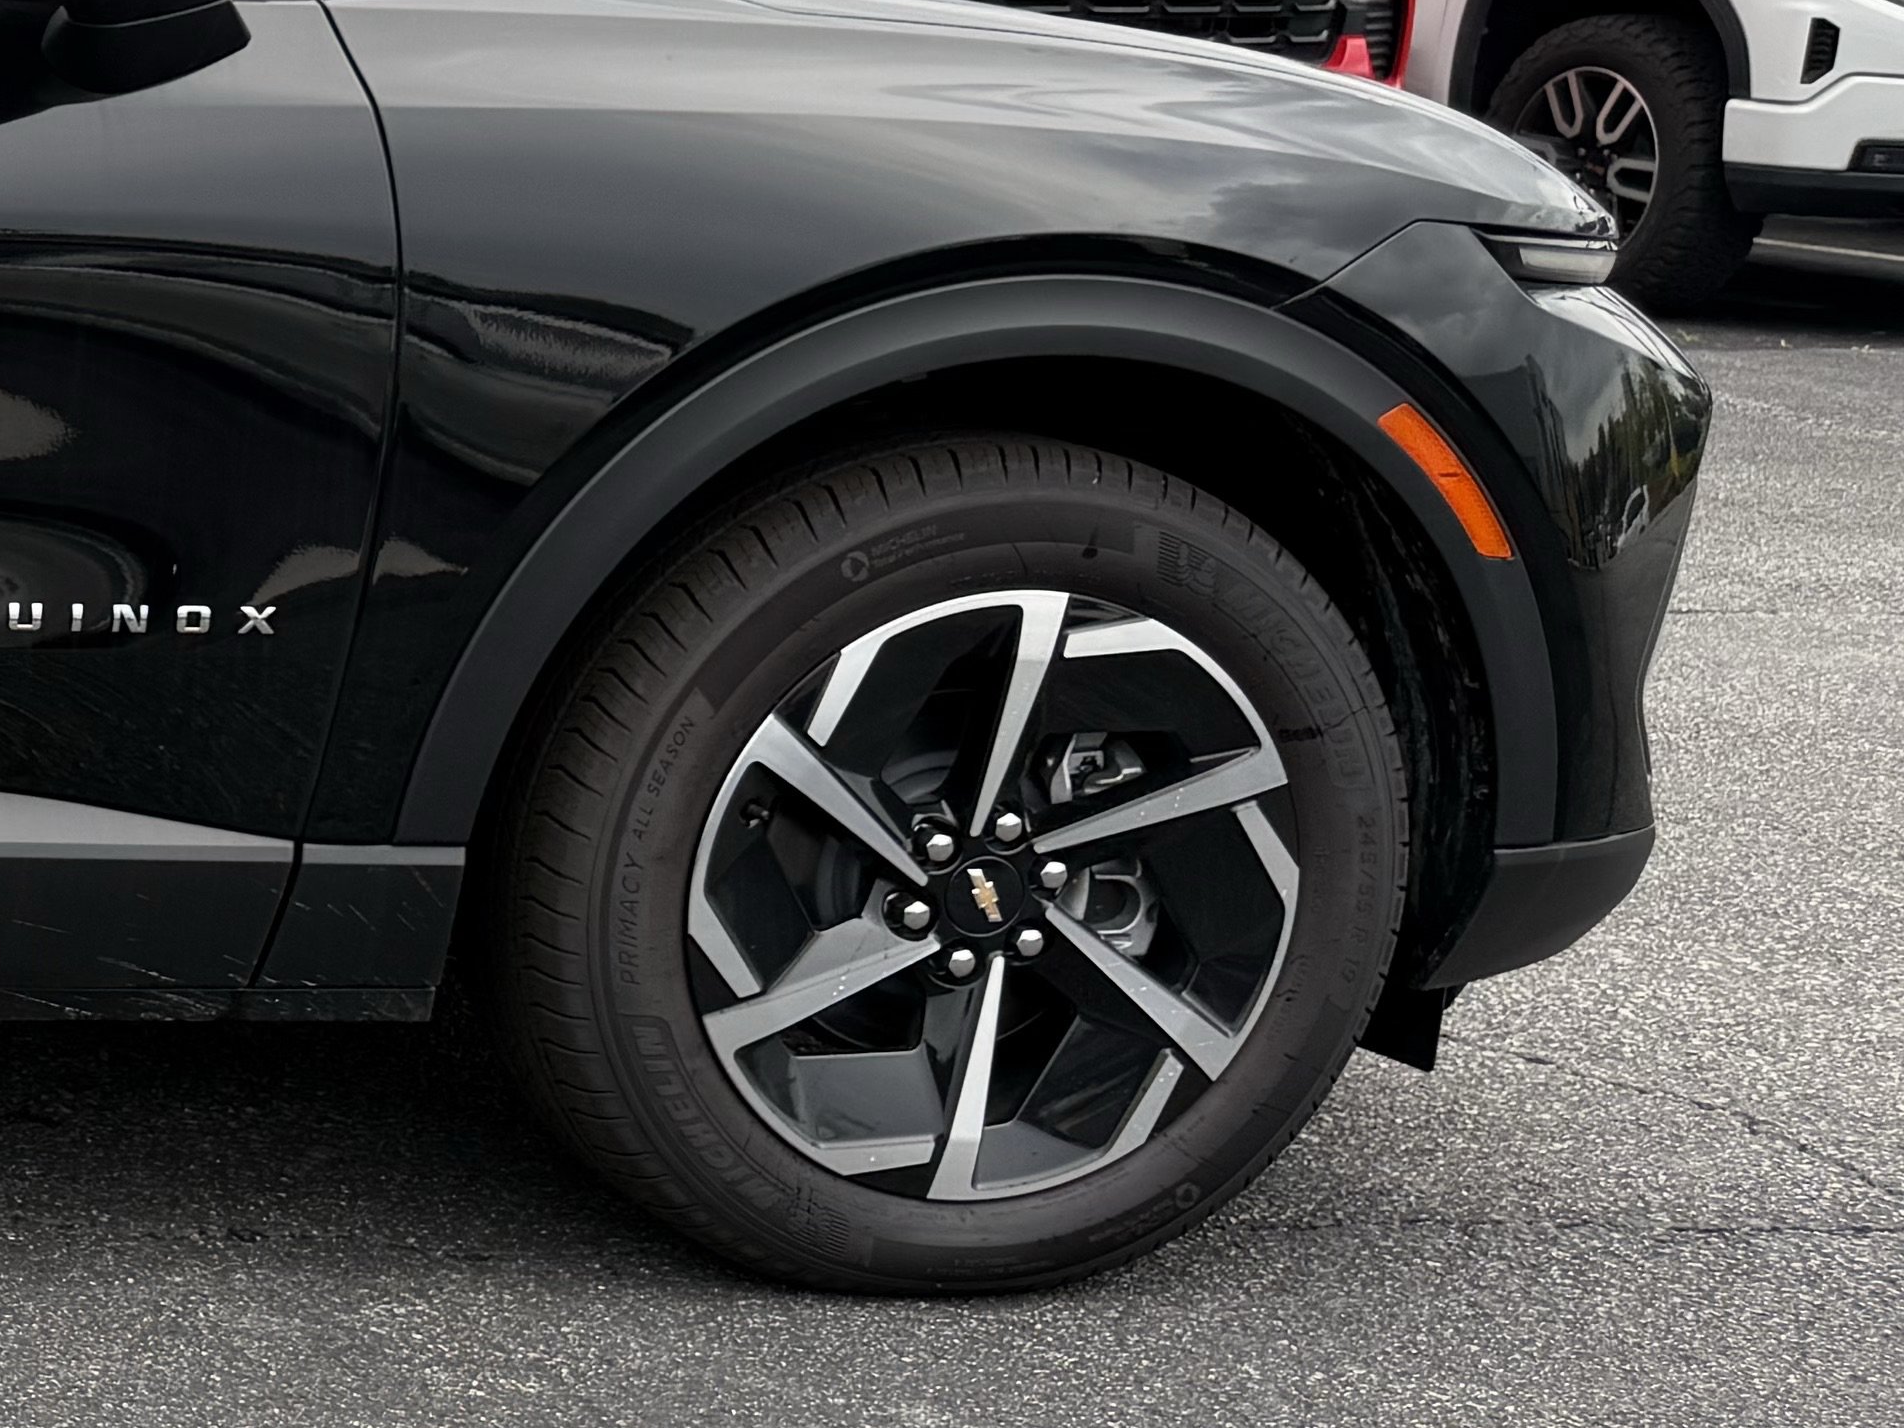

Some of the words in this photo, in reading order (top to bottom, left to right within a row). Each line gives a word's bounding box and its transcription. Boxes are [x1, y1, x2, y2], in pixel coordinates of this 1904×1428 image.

[1221, 581, 1366, 778] MICHELIN
[618, 850, 644, 987] PRIMACY
[631, 805, 655, 843] ALL
[647, 715, 696, 799] SEASON
[1355, 814, 1378, 915] 245/55
[1339, 956, 1361, 985] 19
[1349, 925, 1369, 945] R
[631, 1024, 779, 1211] MICHELIN
